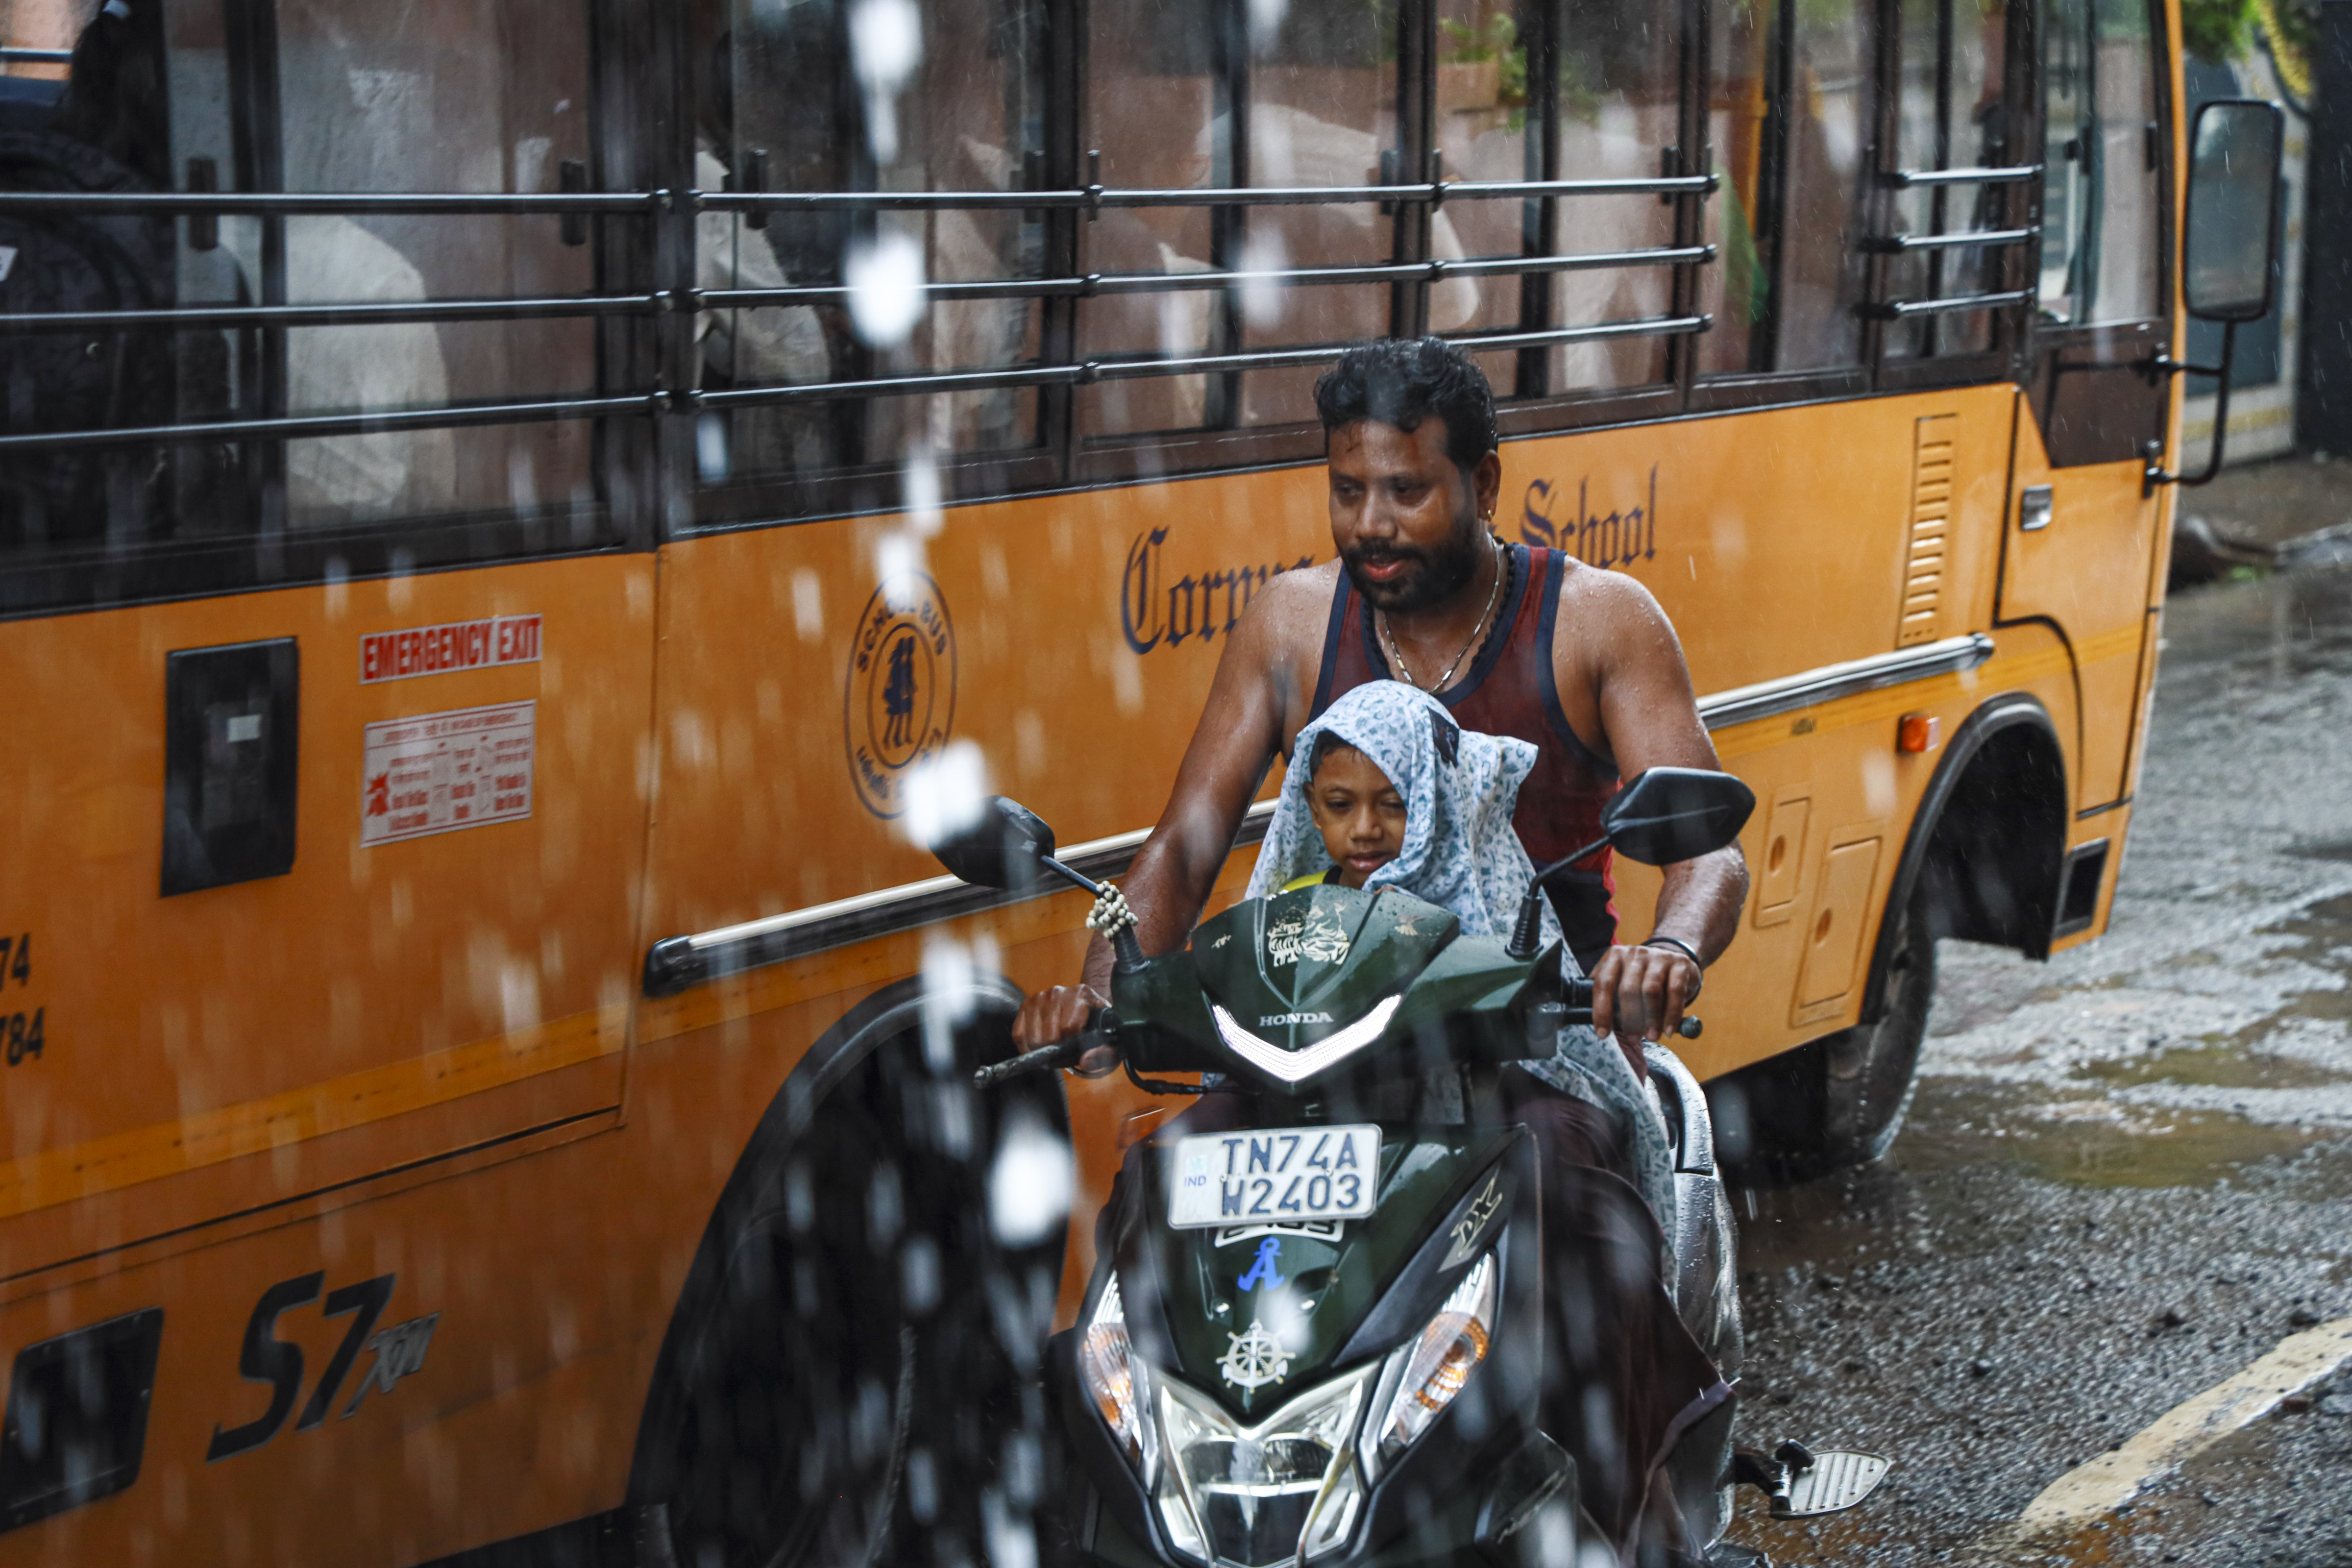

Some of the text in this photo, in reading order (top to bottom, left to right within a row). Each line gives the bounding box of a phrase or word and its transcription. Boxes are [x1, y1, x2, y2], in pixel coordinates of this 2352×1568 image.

[365, 617, 541, 680] EMERGENCY EXIT
[1259, 1012, 1334, 1027] HONDA
[1222, 1132, 1358, 1174] TN74A
[1183, 1176, 1207, 1187] IND
[1222, 1175, 1361, 1216] W2403
[206, 1269, 397, 1465] S7
